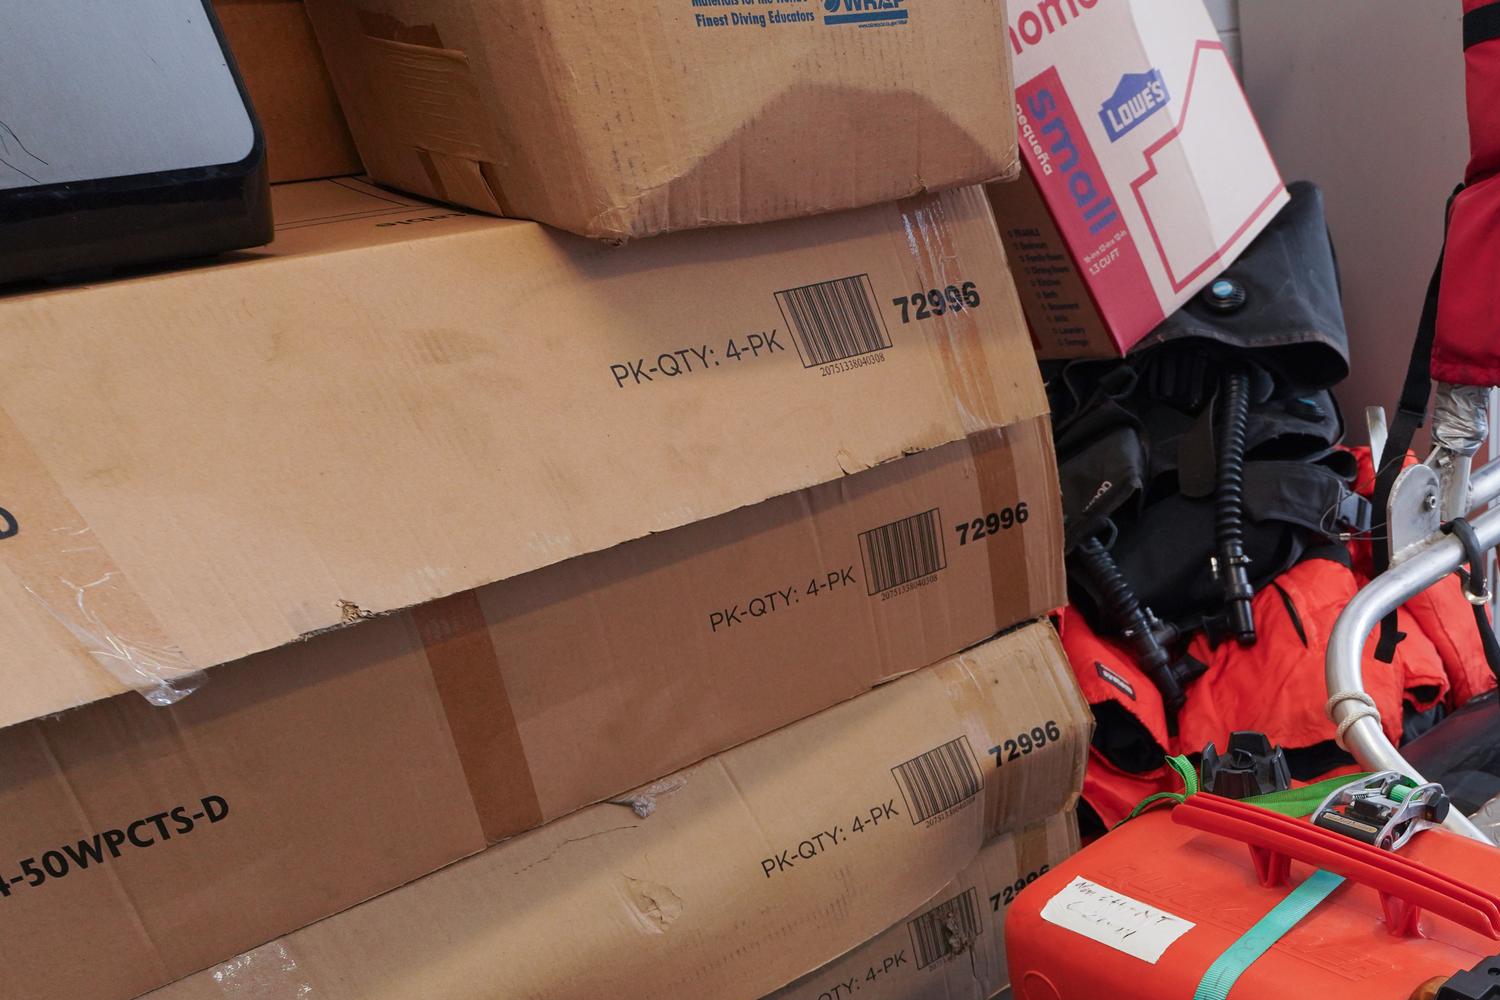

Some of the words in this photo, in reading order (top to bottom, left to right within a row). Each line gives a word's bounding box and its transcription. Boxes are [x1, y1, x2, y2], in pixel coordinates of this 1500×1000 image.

[695, 14, 728, 27] Finest
[731, 12, 766, 27] Diving
[768, 10, 815, 24] Educators
[1107, 80, 1165, 133] LOWE'S
[1027, 88, 1117, 235] small
[892, 282, 980, 323] 72996
[610, 344, 720, 388] PK-QTY:
[725, 329, 785, 361] 4-PK
[819, 353, 886, 377] 20751338040308
[955, 502, 1029, 546] 72996
[709, 586, 799, 632] PK-QTY:
[806, 566, 856, 597] 4-PK
[988, 720, 1061, 769] 72996
[760, 825, 847, 878] PK-QTY:
[851, 799, 901, 834] 4-PK
[865, 950, 907, 982] 4-PK
